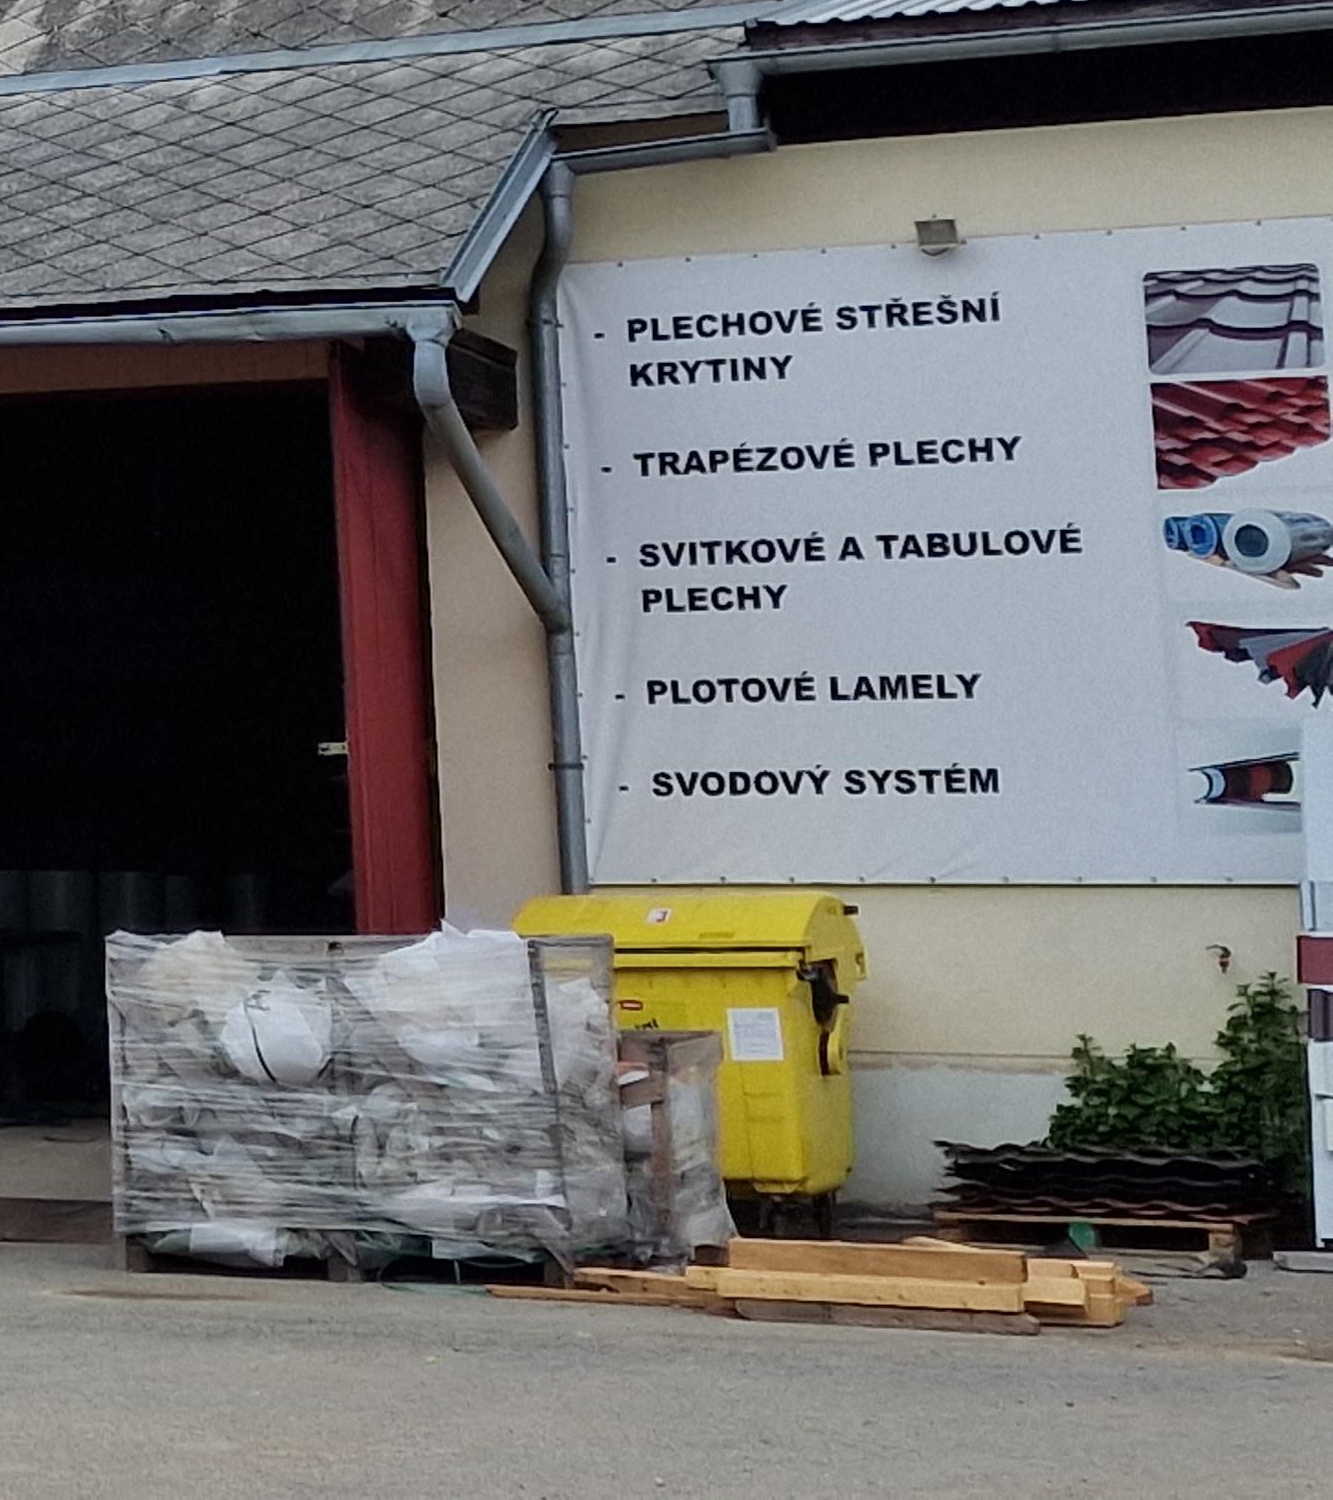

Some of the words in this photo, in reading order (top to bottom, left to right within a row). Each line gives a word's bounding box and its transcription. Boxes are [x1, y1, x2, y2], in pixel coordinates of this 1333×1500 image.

[626, 302, 823, 343] PLECHOVÉ
[836, 291, 1000, 331] STŘEŠNÍ
[629, 354, 793, 388] KRYTINY
[633, 437, 855, 477] TRAPÉZOVÉ
[868, 435, 1022, 468] PLECHY
[639, 531, 826, 568] SVITKOVÉ
[838, 536, 865, 562] A
[875, 522, 1083, 560] TABULOVÉ
[641, 584, 788, 613] PLECHY
[646, 670, 816, 705] PLOTOVÉ
[829, 673, 982, 701] LAMELY
[652, 764, 830, 797] SVODOVÝ
[843, 762, 1000, 795] SYSTÉM
